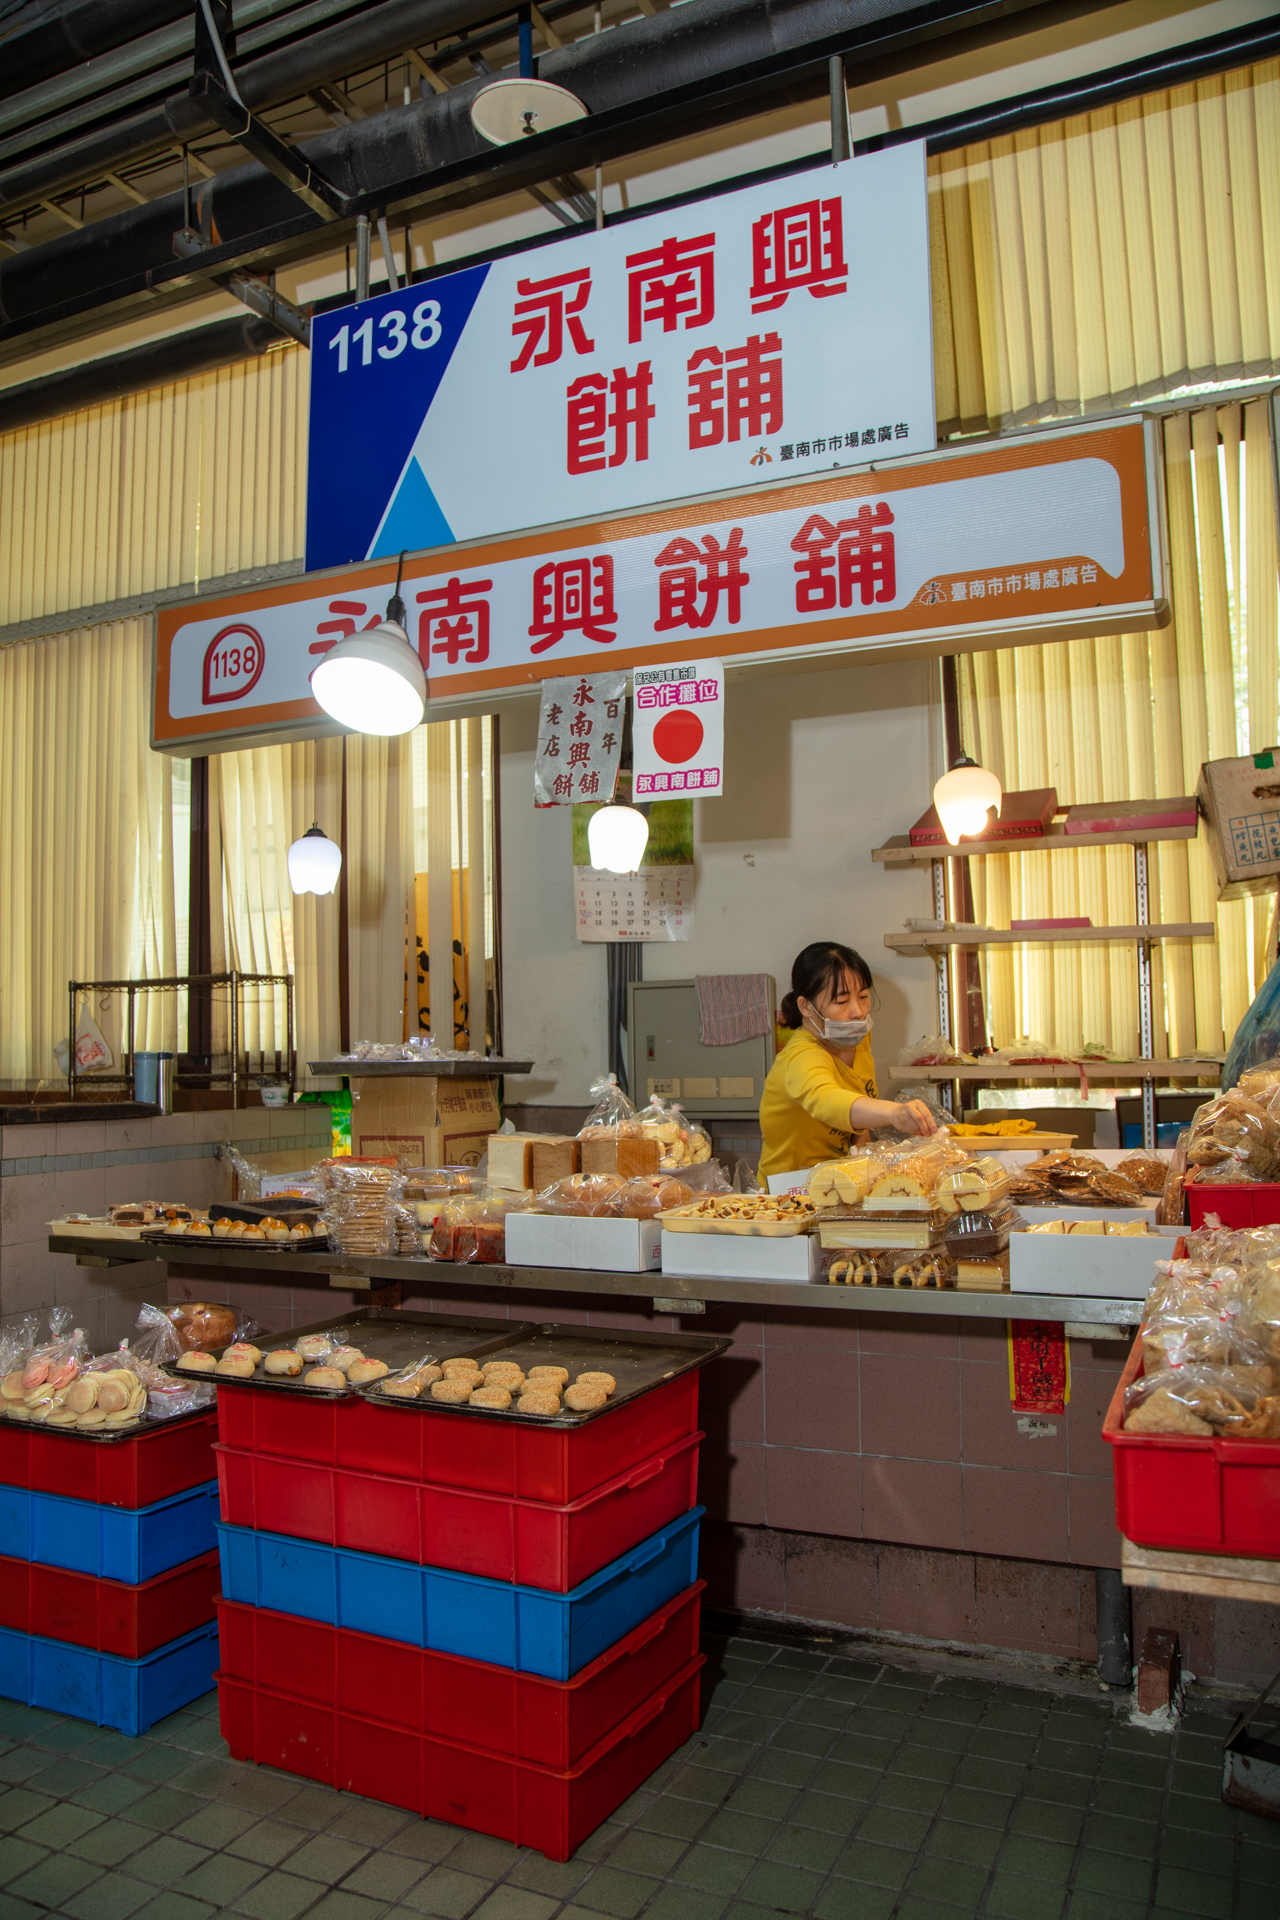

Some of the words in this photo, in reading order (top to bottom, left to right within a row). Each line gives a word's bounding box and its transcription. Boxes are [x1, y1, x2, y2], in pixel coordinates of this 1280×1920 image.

[511, 196, 848, 373] 永南興
[329, 300, 442, 372] 1138
[567, 331, 783, 476] 餅舖
[780, 422, 909, 461] 臺南市市場處廣告
[951, 563, 1099, 602] 臺南市市場處廣告
[213, 645, 257, 680] 1138
[637, 679, 719, 709] 合作攤位
[543, 703, 563, 757] 老店
[601, 698, 621, 755] 百年
[636, 767, 721, 794] 永興南餅舖
